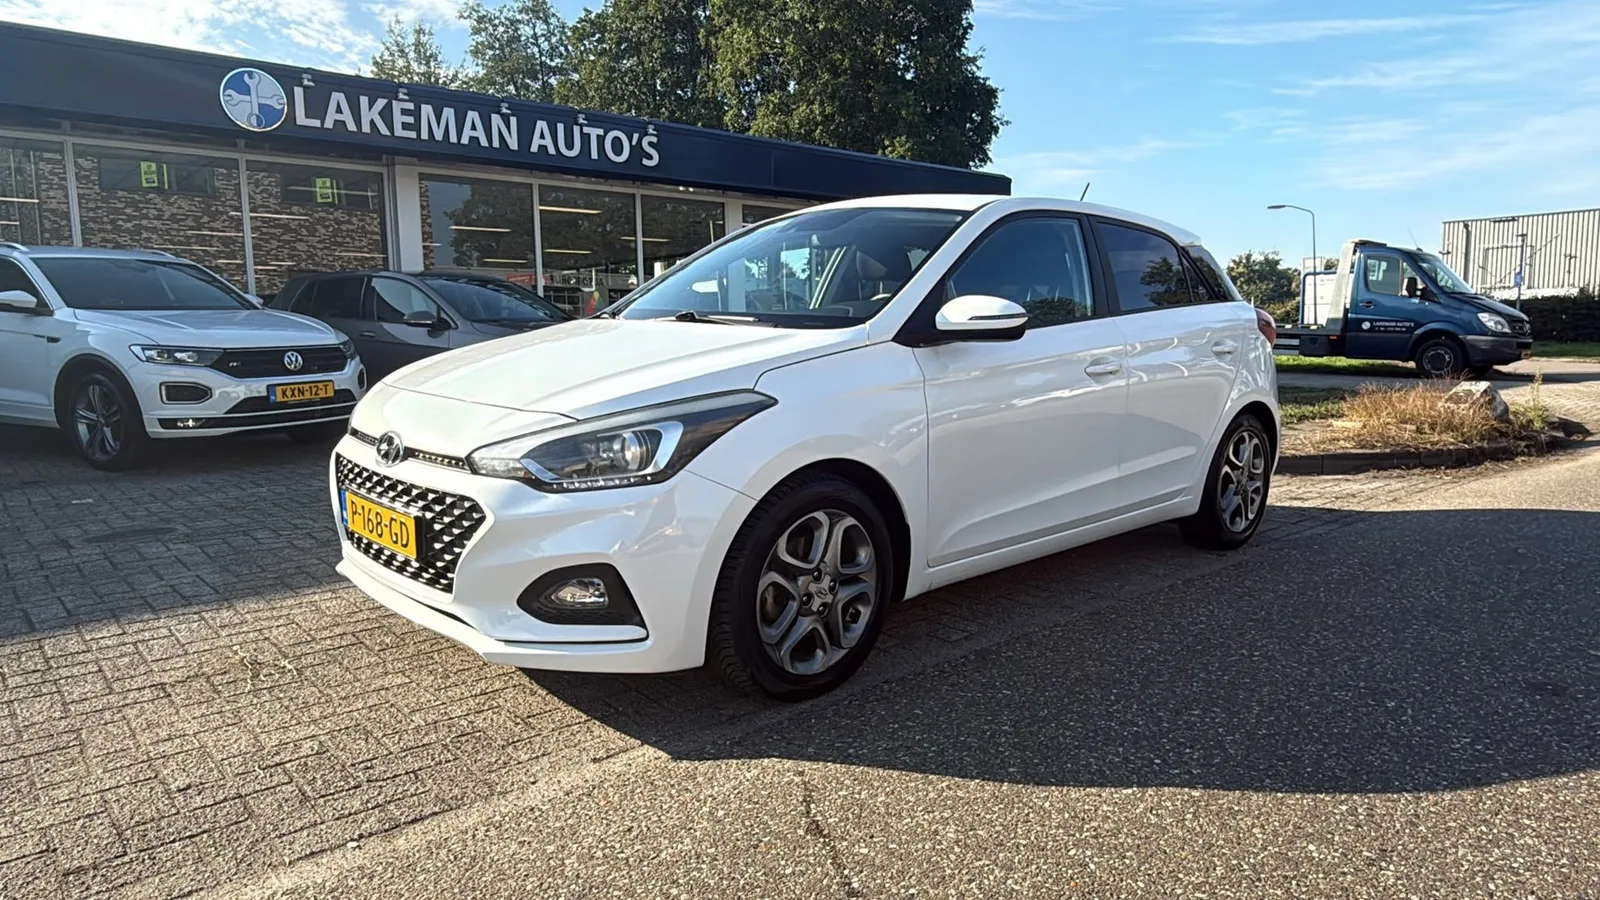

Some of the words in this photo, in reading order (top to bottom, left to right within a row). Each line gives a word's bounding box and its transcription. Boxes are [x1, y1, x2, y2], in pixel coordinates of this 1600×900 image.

[294, 86, 519, 151] LAKEMAN
[530, 120, 660, 167] AUTO'S
[281, 383, 330, 399] KXN-12-T
[350, 499, 410, 549] P-168-GD
